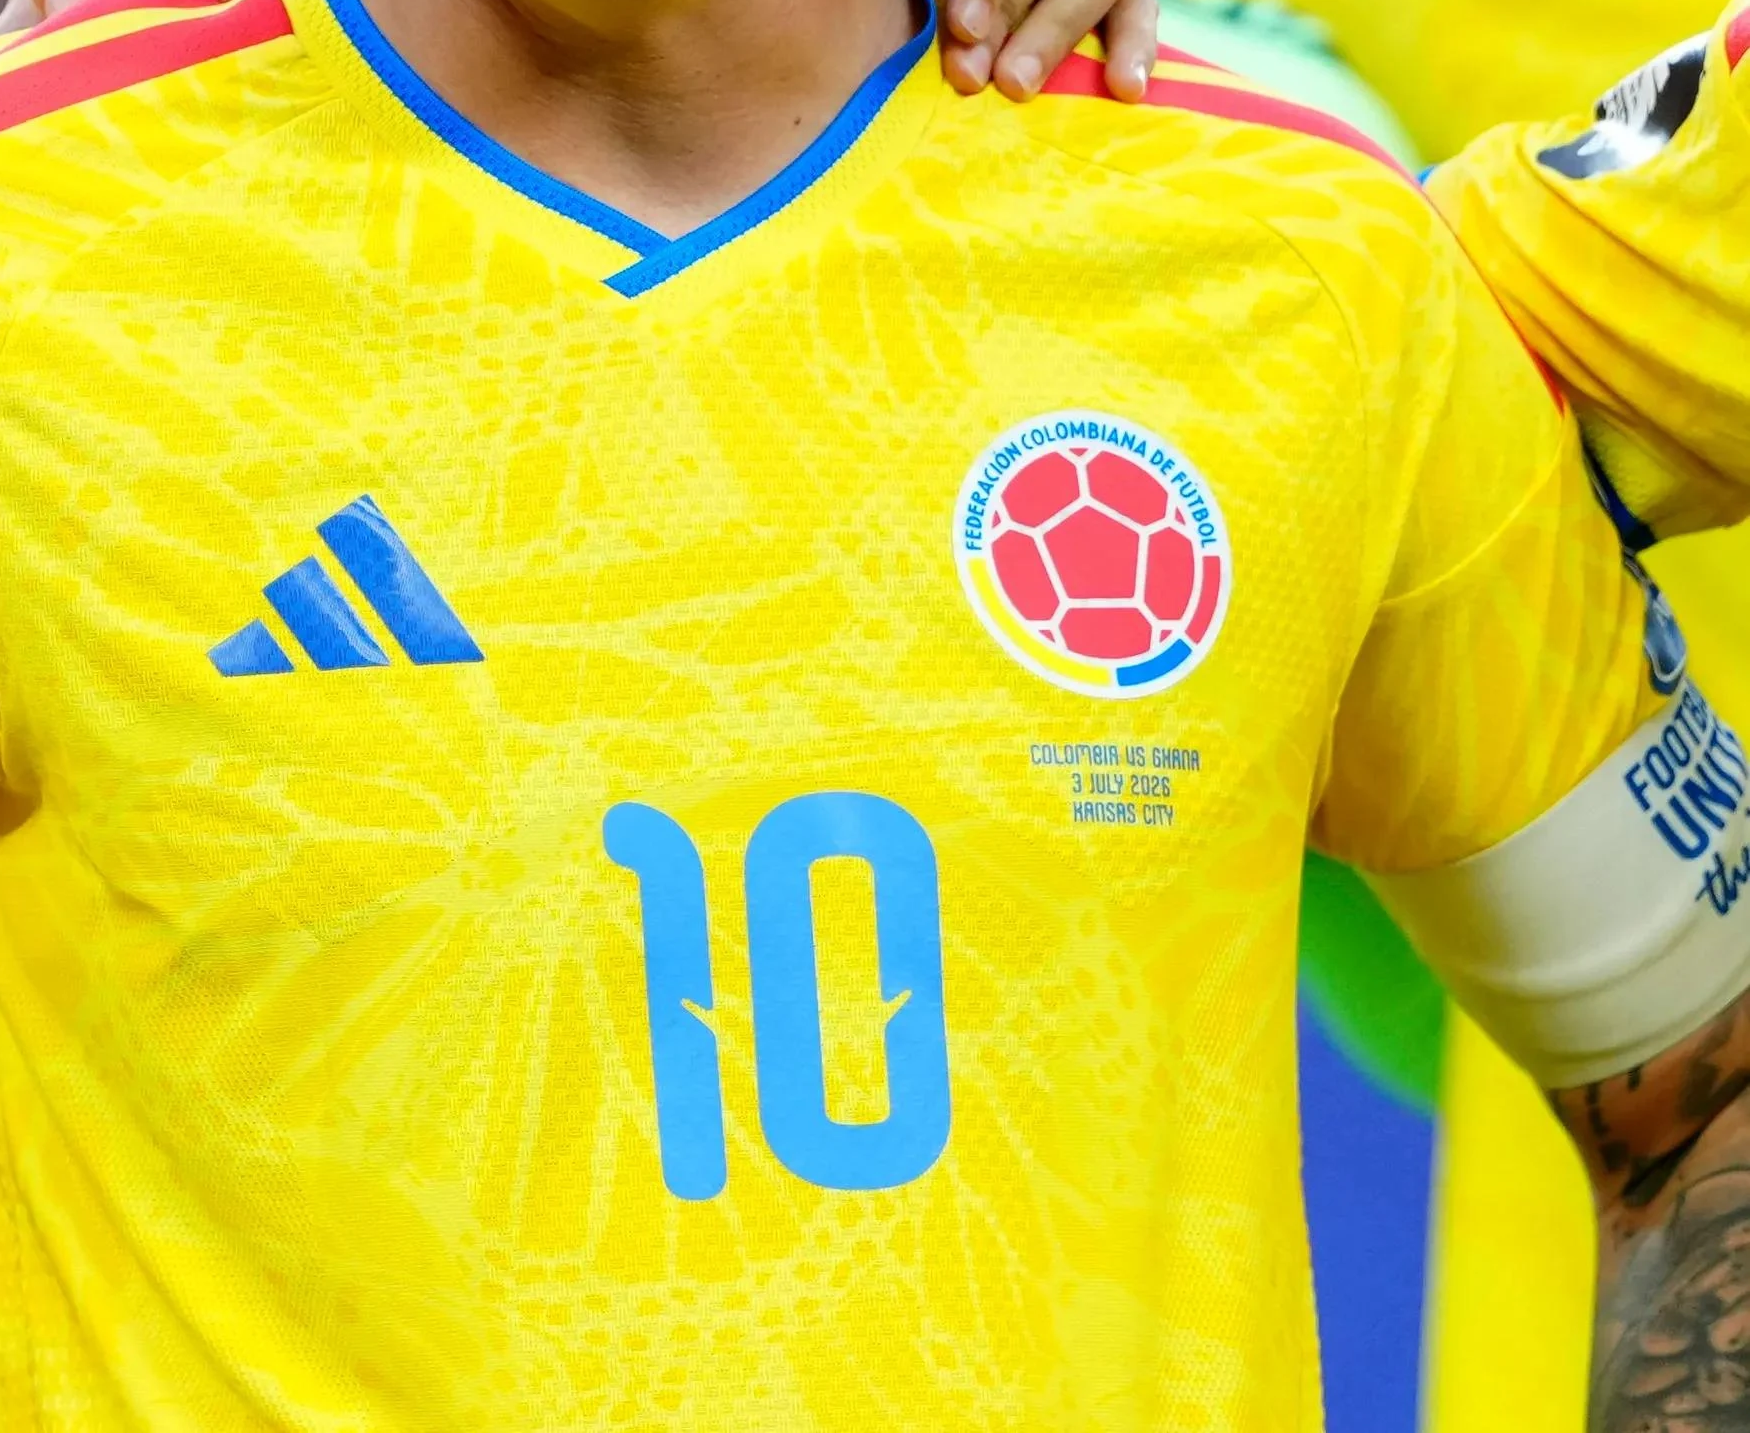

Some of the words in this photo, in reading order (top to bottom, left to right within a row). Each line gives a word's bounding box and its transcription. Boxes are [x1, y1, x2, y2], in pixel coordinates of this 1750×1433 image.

[966, 441, 1022, 551] FEDERACIÓN
[1021, 421, 1147, 458] COLOMBIANA
[1149, 449, 1176, 476] DE
[1170, 470, 1217, 548] FÚTBOL
[1030, 743, 1119, 766] COLOMBIA
[1152, 747, 1201, 772] GHANA
[1071, 773, 1082, 794] 3
[1090, 773, 1124, 795] JULY
[1130, 774, 1171, 797] 2026
[1624, 688, 1708, 812] FOOTB
[1073, 801, 1136, 824] KANSAS
[1143, 804, 1174, 826] CITY
[602, 789, 953, 1202] 10
